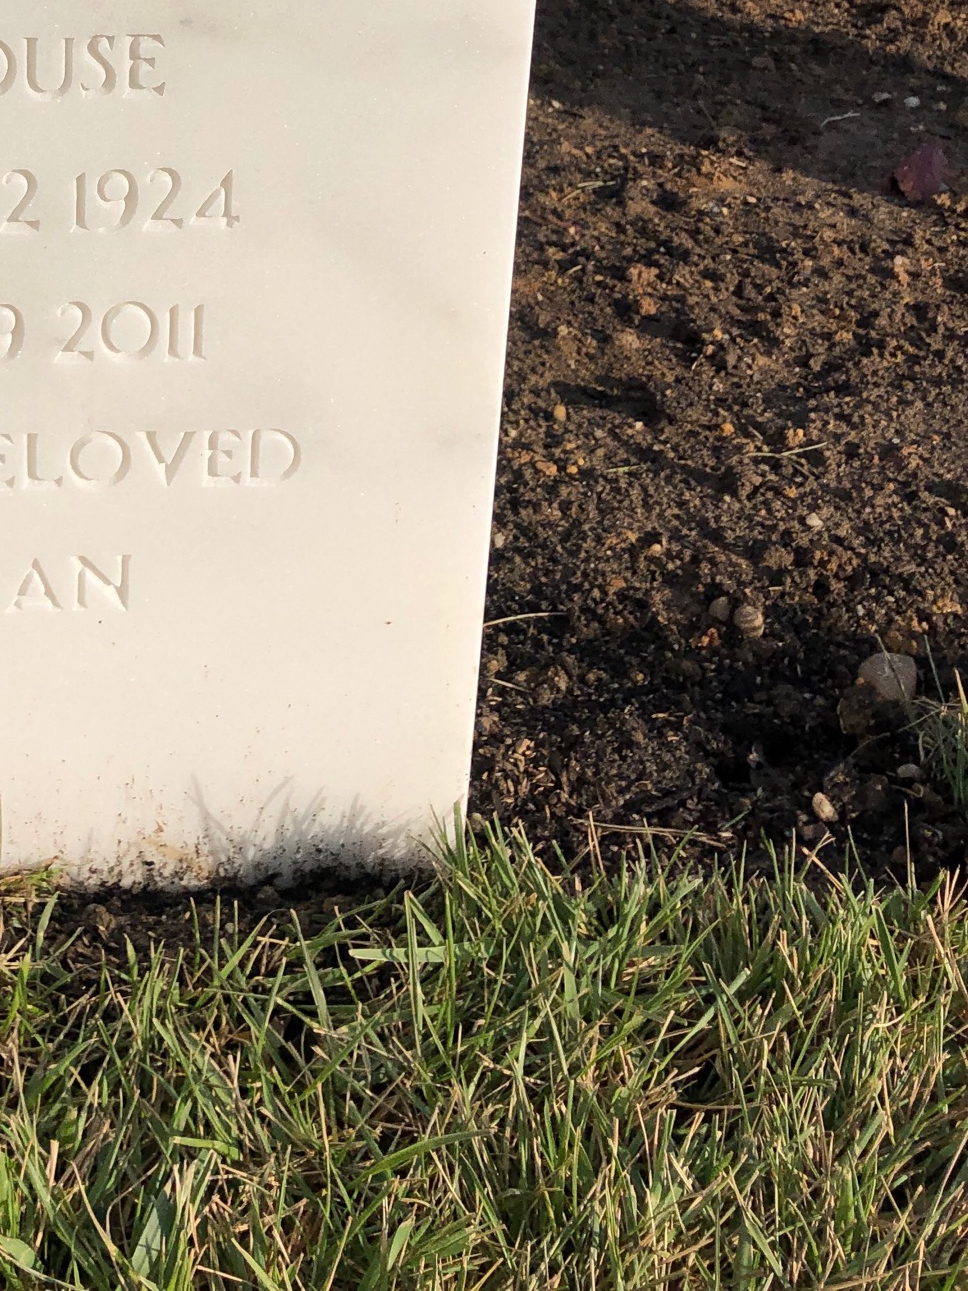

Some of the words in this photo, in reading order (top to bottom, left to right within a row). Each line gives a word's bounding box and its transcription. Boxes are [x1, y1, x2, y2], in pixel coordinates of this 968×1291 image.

[0, 168, 40, 232] 2
[71, 166, 241, 232] 1924
[54, 300, 208, 363] 2011
